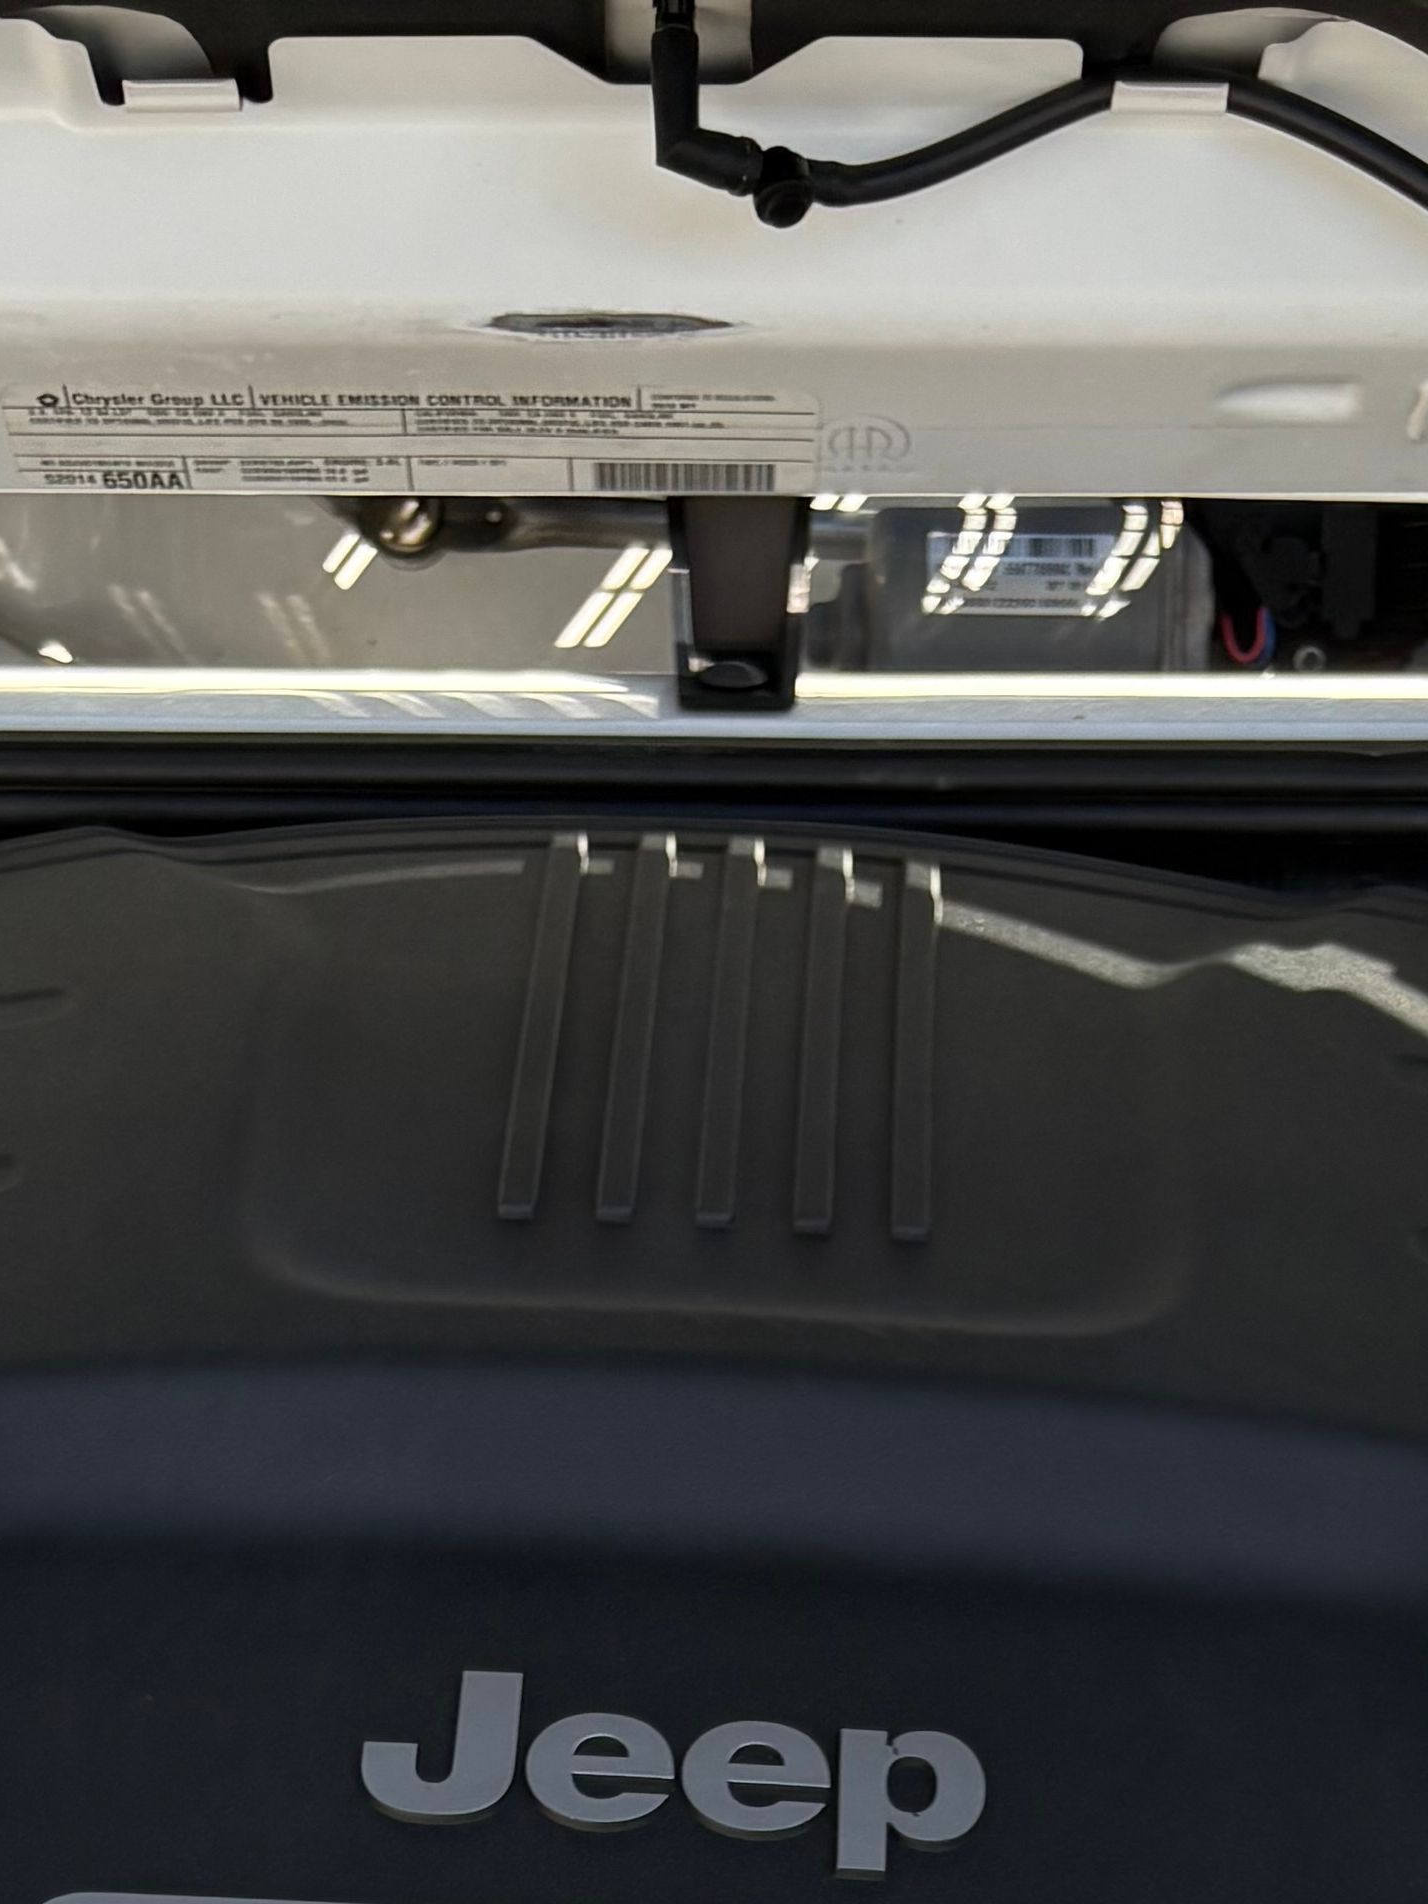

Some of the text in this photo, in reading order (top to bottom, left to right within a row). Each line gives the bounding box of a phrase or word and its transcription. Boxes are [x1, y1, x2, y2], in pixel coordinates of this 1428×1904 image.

[72, 393, 246, 408] Chrysler Group LLC
[259, 394, 632, 408] VEHICLE EMISSION CONTROL INFORMATION
[360, 1669, 987, 1881] Jeep
